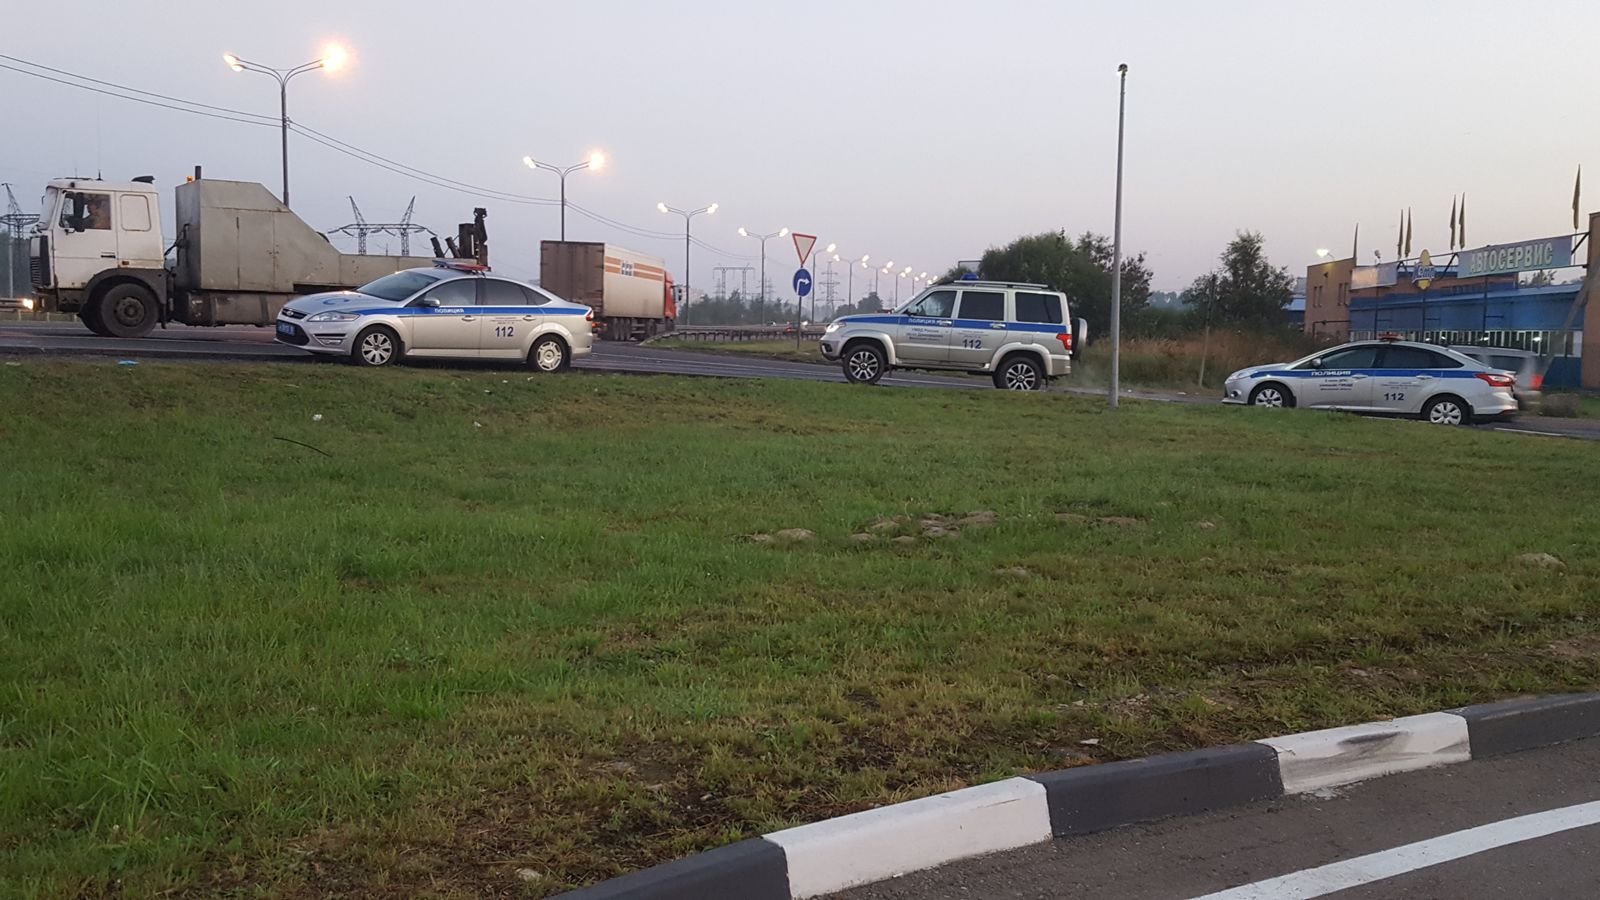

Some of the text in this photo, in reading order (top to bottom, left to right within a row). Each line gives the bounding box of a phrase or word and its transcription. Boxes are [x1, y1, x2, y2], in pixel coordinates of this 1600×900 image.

[1470, 242, 1553, 273] АВТОСЕРВИС
[495, 326, 514, 337] 112
[962, 339, 982, 349] 112
[1383, 393, 1405, 401] 112
